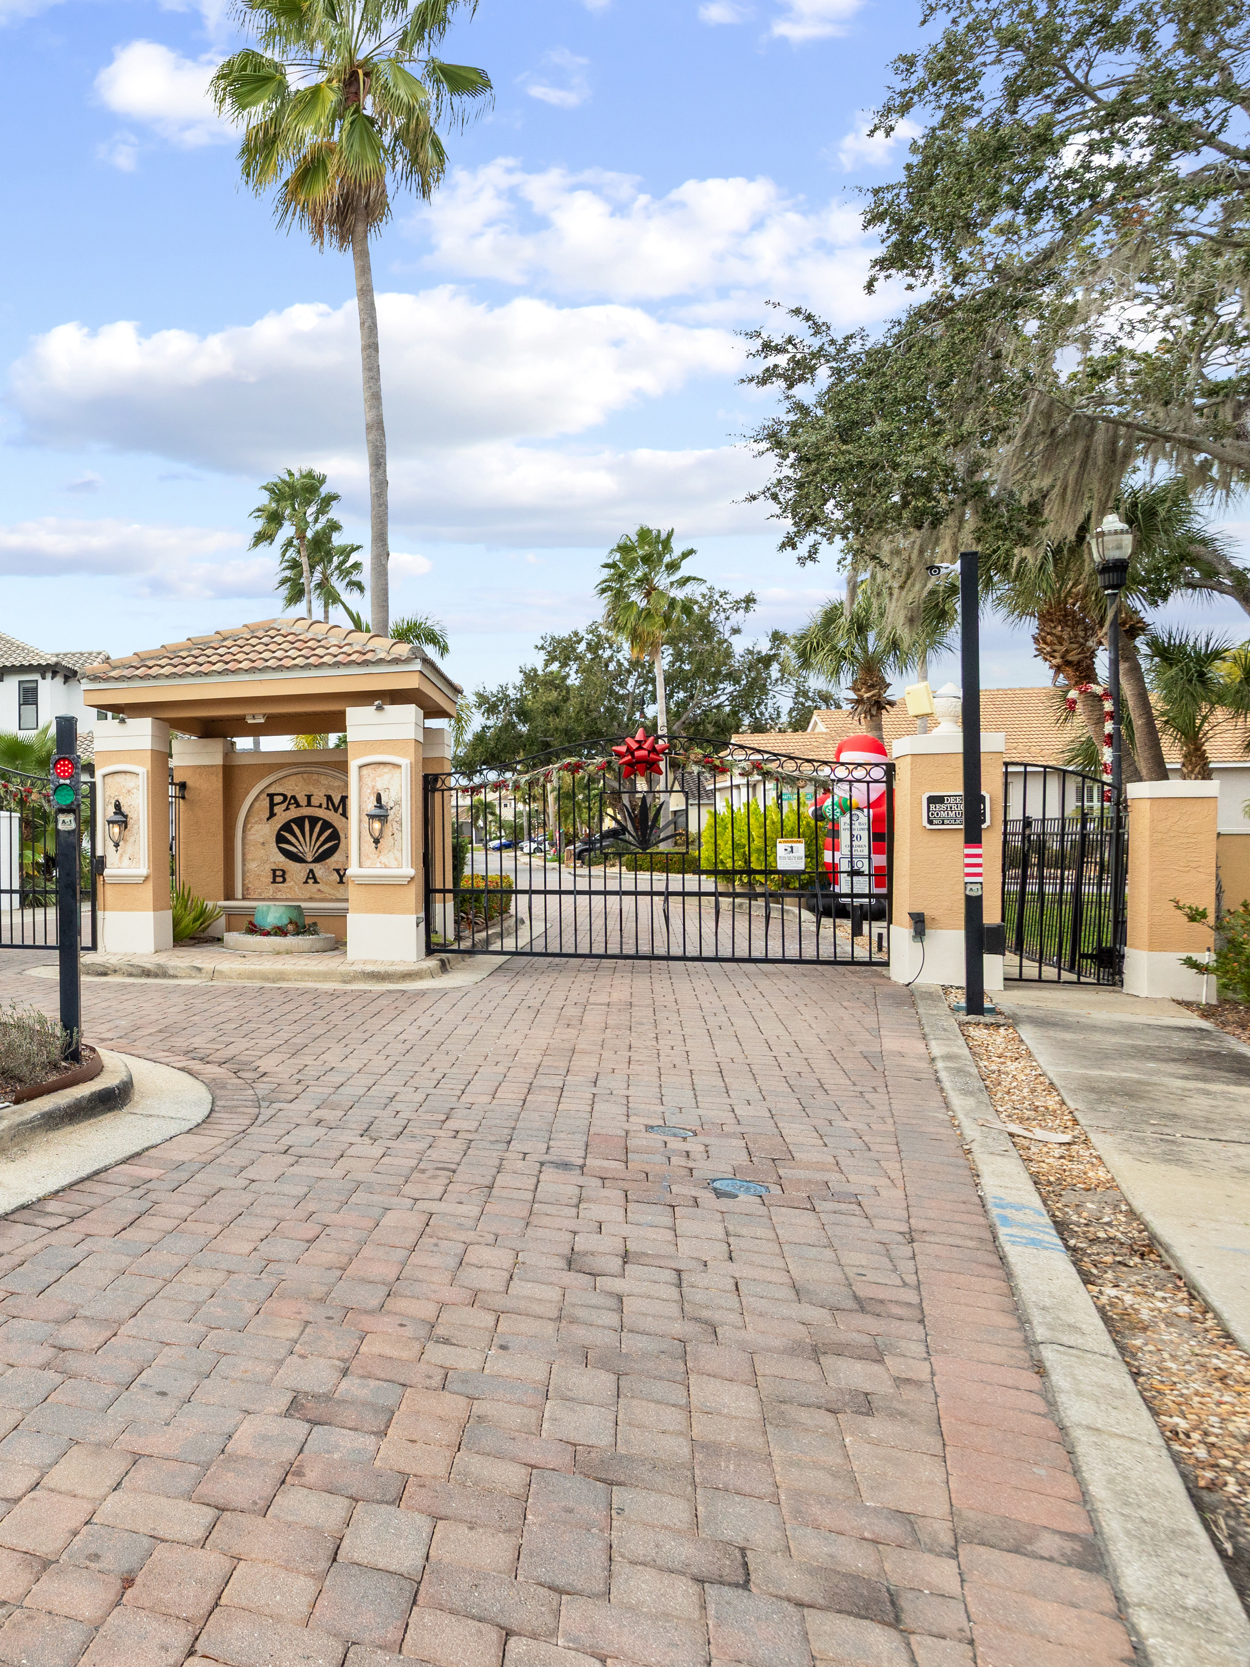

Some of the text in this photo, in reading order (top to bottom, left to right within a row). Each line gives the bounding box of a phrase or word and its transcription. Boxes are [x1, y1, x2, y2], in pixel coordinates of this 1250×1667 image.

[266, 792, 348, 822] PALM
[851, 834, 862, 842] 20
[848, 860, 864, 869] NO
[270, 868, 348, 884] BAY
